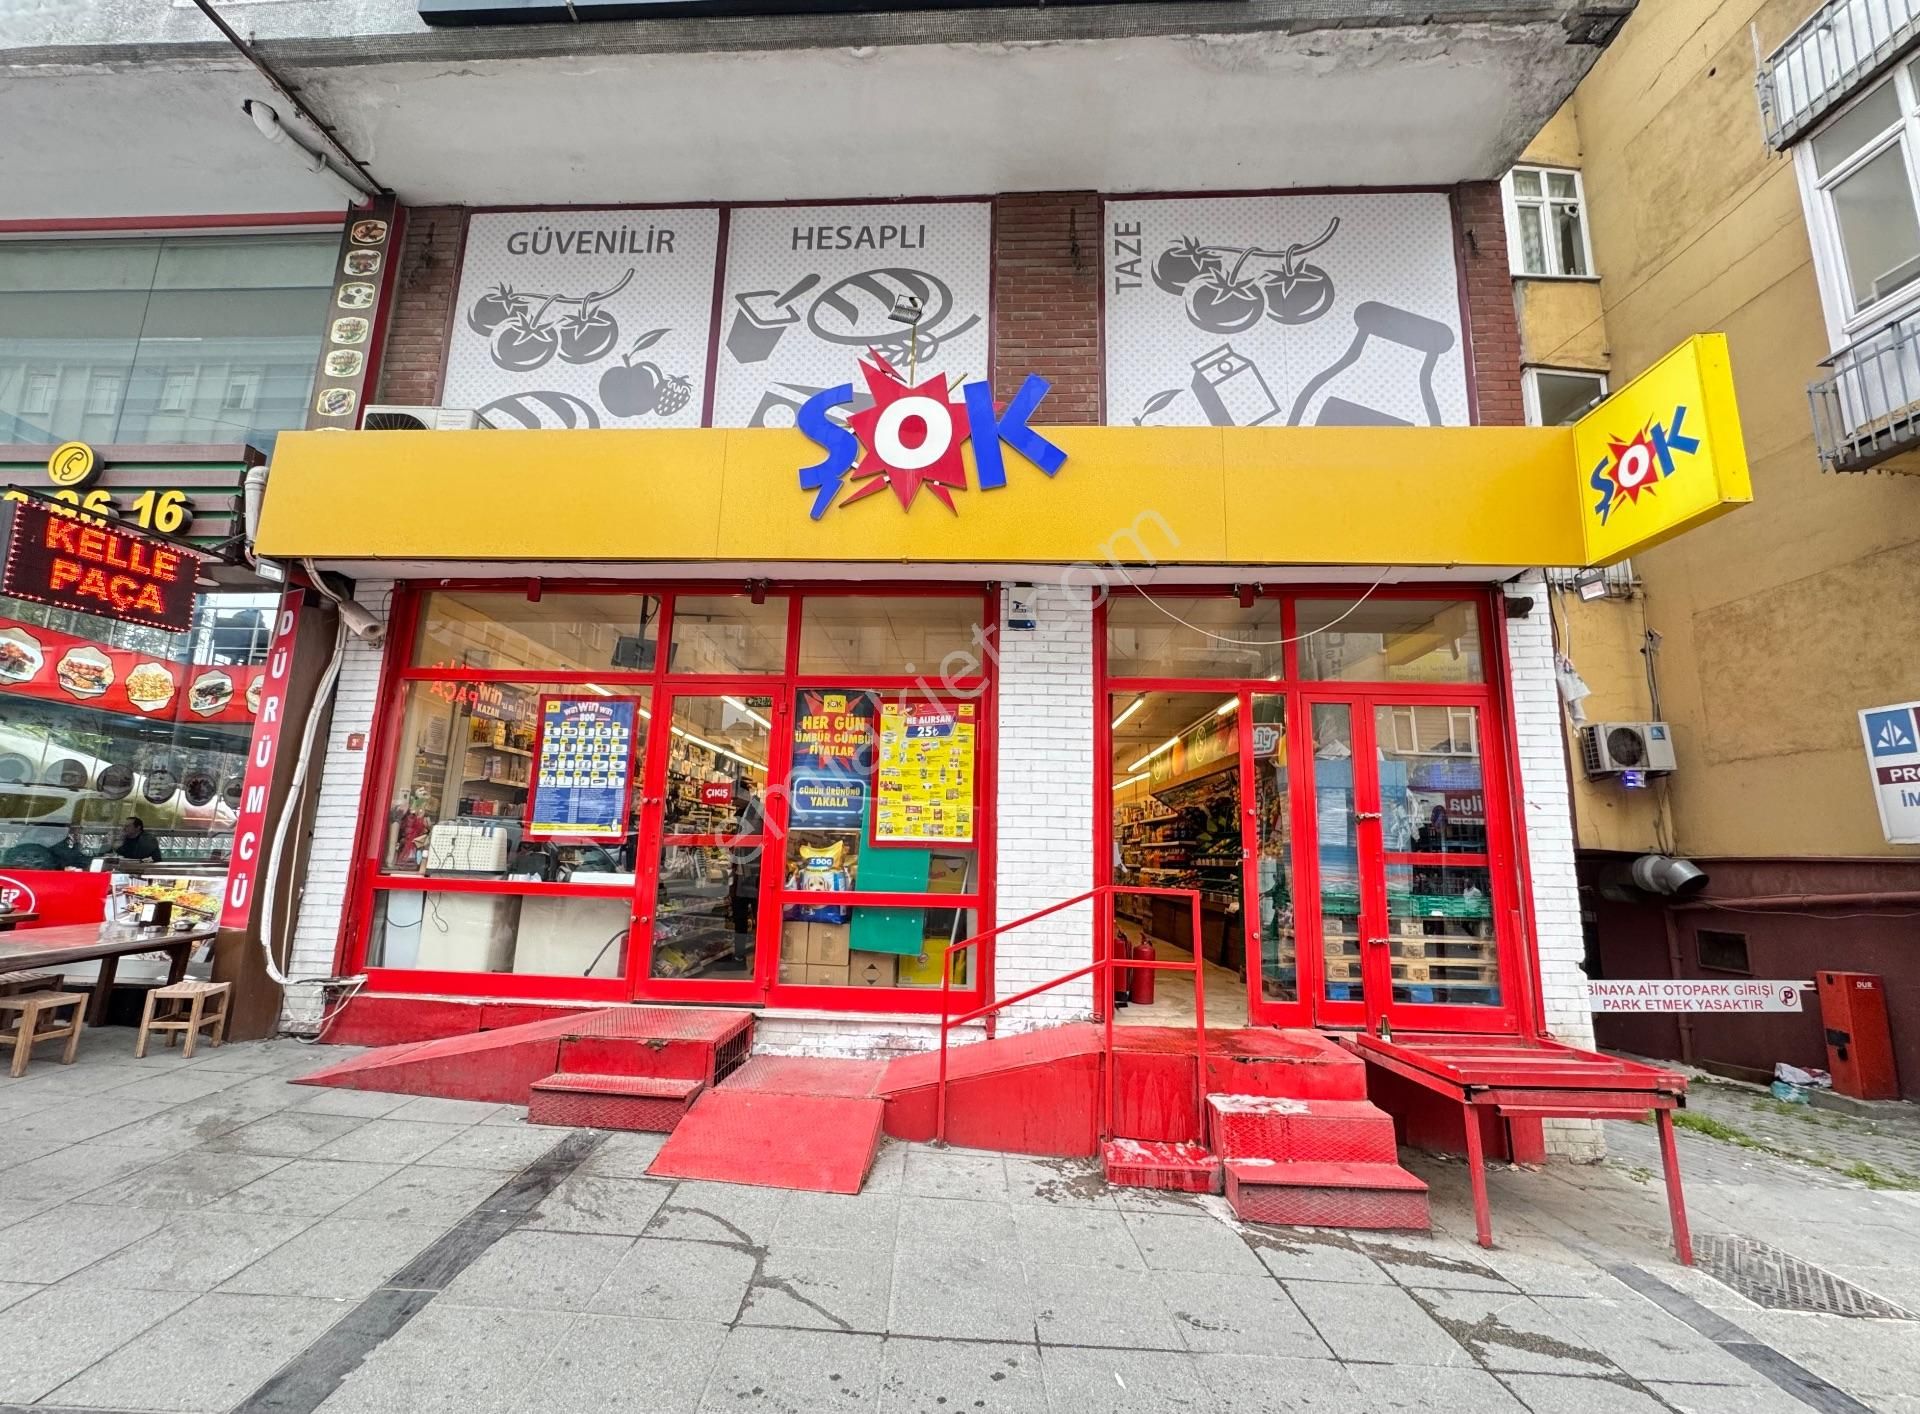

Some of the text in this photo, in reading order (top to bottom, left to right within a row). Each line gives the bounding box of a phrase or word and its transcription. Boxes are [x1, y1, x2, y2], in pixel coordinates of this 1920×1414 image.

[507, 225, 676, 255] GÜVENİLİR
[791, 224, 926, 250] HESAPLI
[1114, 221, 1142, 296] TAZE
[797, 371, 1069, 522] ŞOK
[1590, 405, 1701, 527] ŞOK
[132, 490, 187, 533] 16
[46, 516, 181, 583] KELLE
[50, 557, 164, 614] PAÇA
[802, 713, 865, 731] HER GÜN
[920, 715, 952, 725] ALIRSAN
[795, 731, 831, 743] ÜMBÜR
[809, 743, 855, 756] FİYATLAR
[230, 609, 294, 908] DÜRÜMCÜ
[706, 788, 728, 799] ÇIKIŞ
[811, 797, 848, 807] YAKALA
[1587, 982, 1774, 998] BİNAYA AİT OTOPARK GİRİŞİ
[1603, 999, 1764, 1010] PARK ETMEK YASAKTIR
